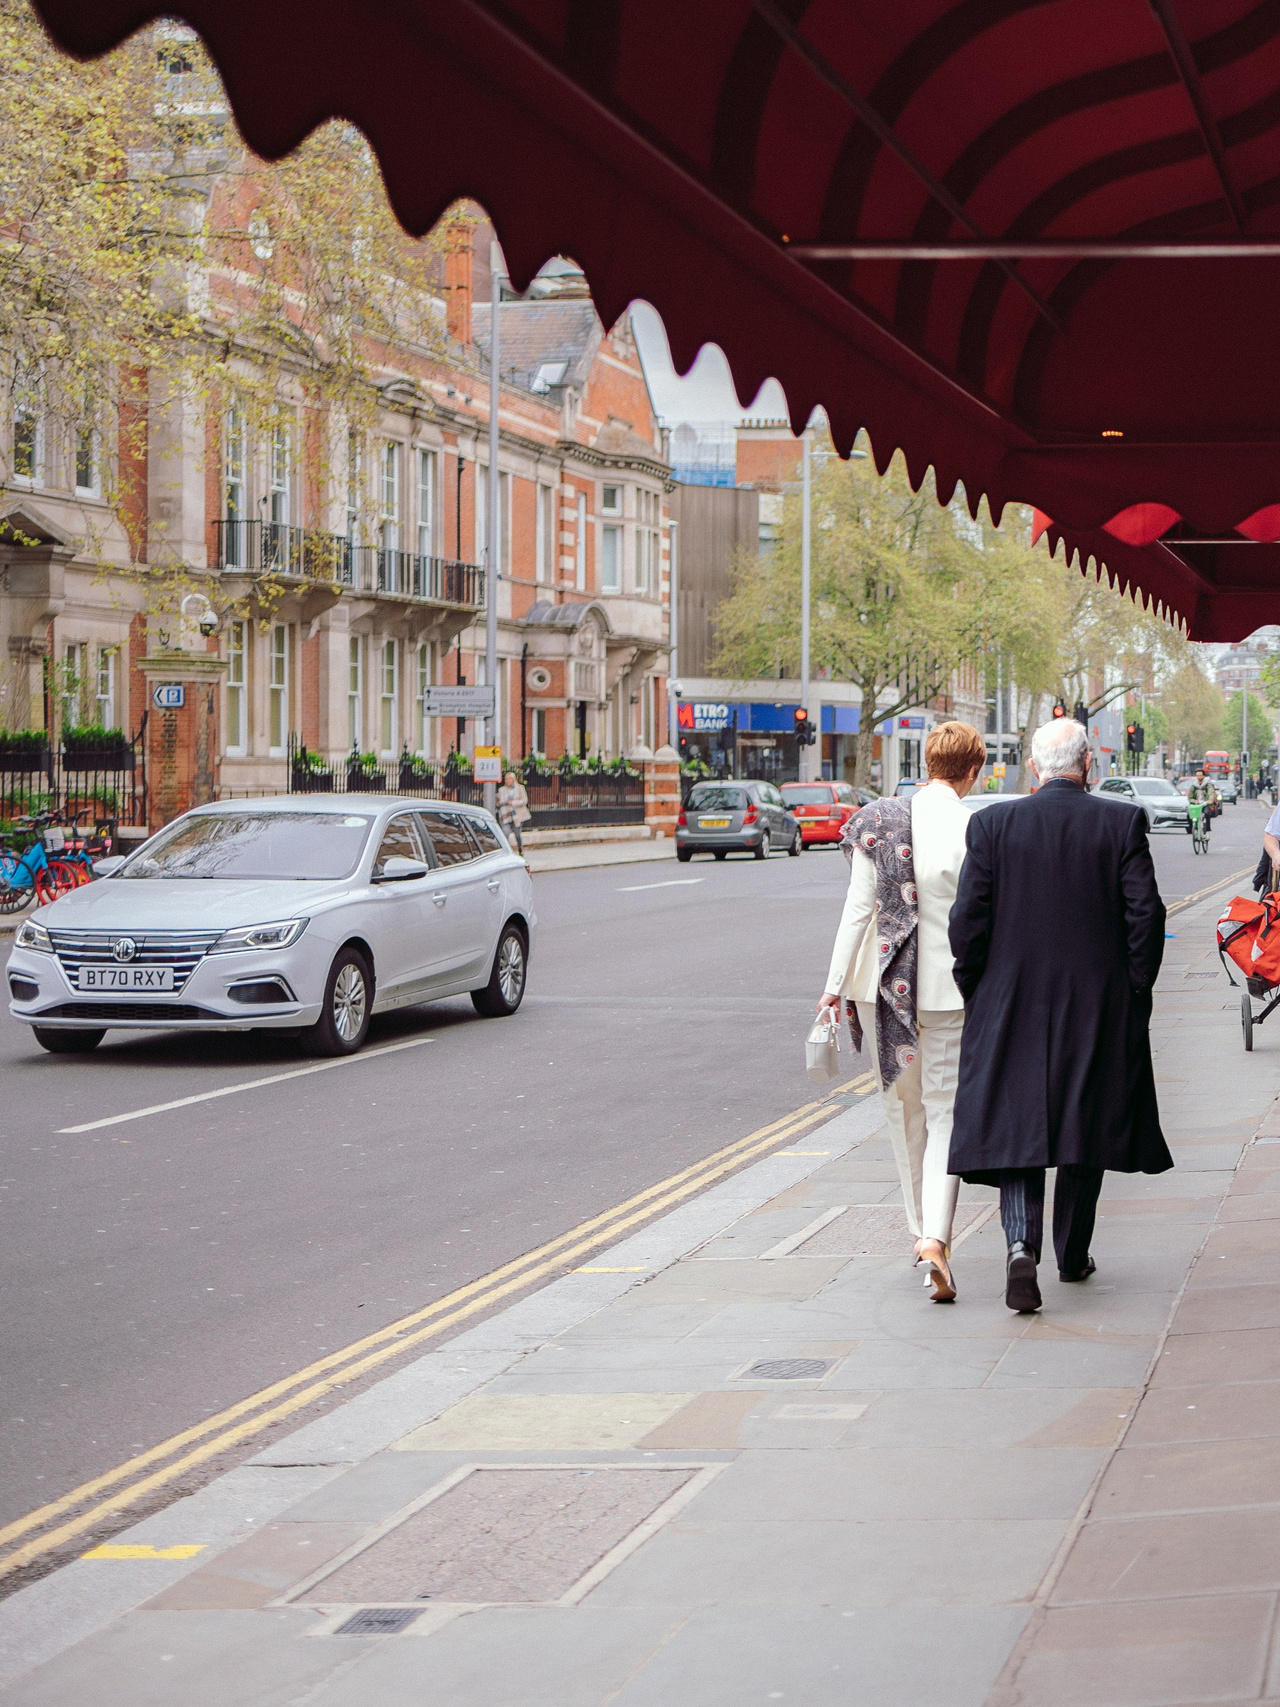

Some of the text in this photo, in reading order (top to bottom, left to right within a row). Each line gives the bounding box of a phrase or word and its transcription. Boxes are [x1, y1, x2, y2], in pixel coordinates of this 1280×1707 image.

[169, 690, 178, 702] P
[695, 718, 728, 729] BANK
[480, 761, 495, 771] 211
[86, 971, 166, 986] BT70 RXY
